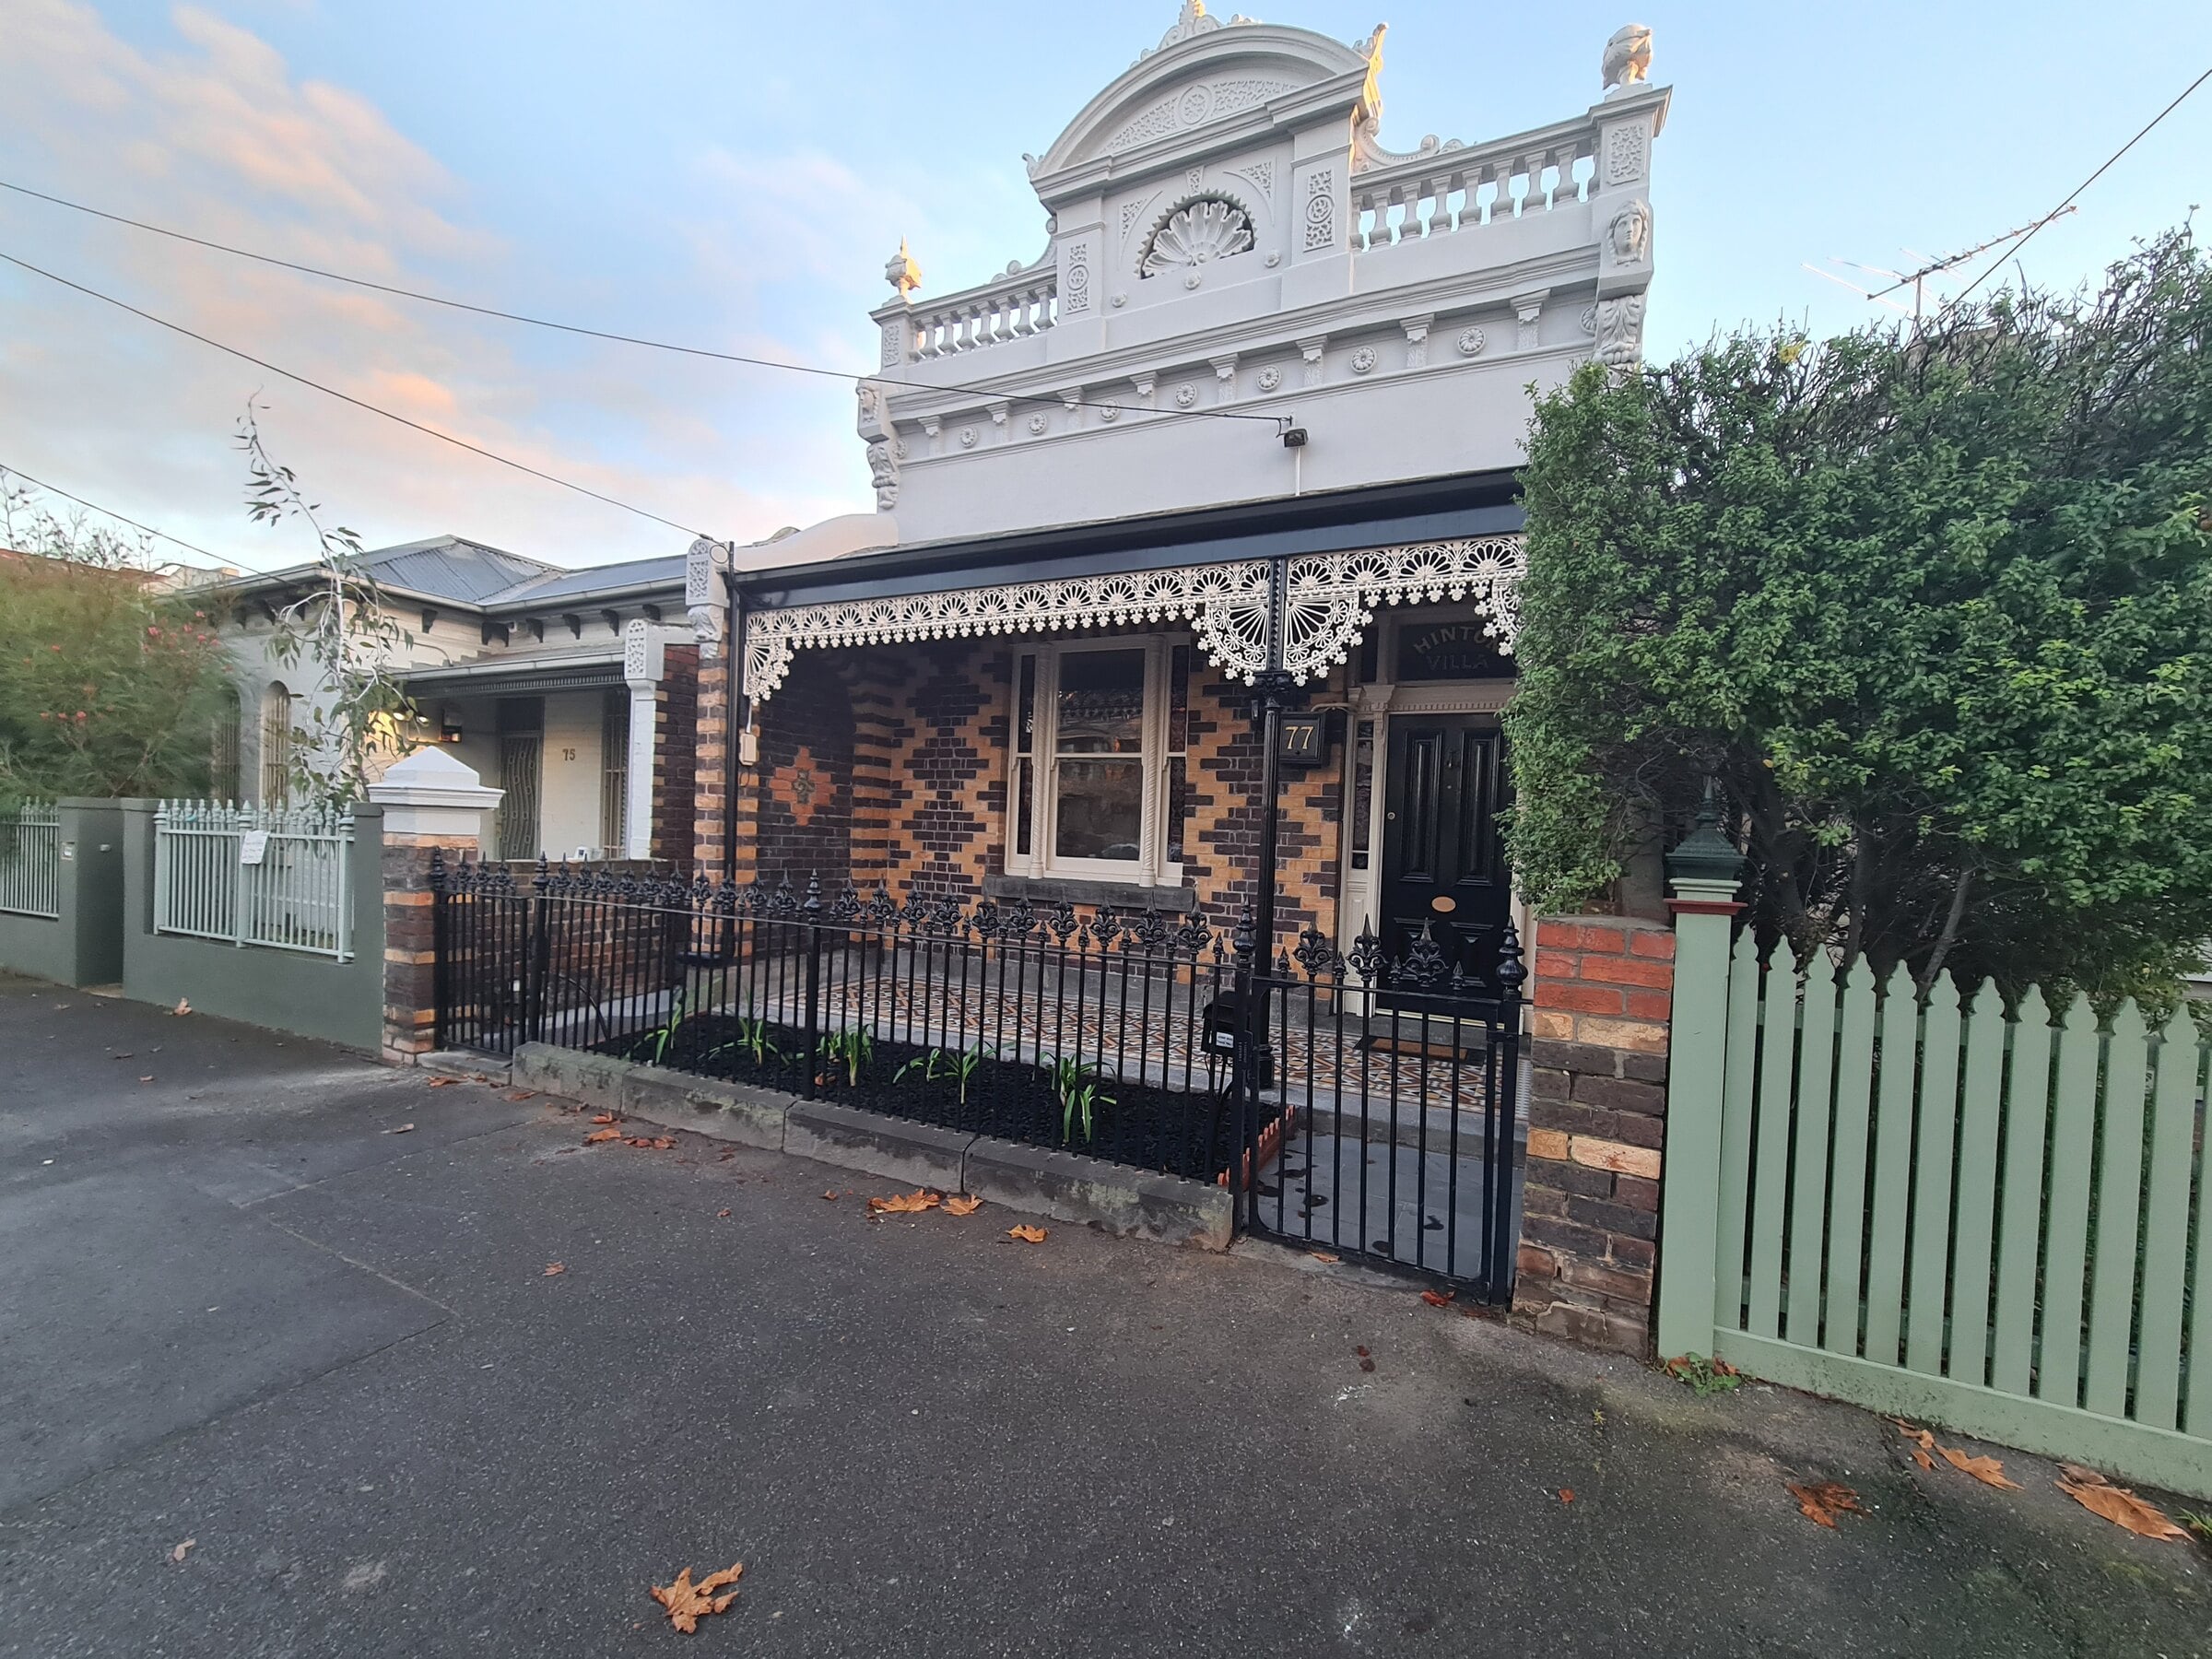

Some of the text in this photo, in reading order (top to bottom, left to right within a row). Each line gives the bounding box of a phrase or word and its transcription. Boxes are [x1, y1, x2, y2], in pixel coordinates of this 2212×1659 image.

[1426, 654, 1489, 670] VILLA
[1285, 725, 1314, 750] 77
[562, 747, 576, 761] 75
